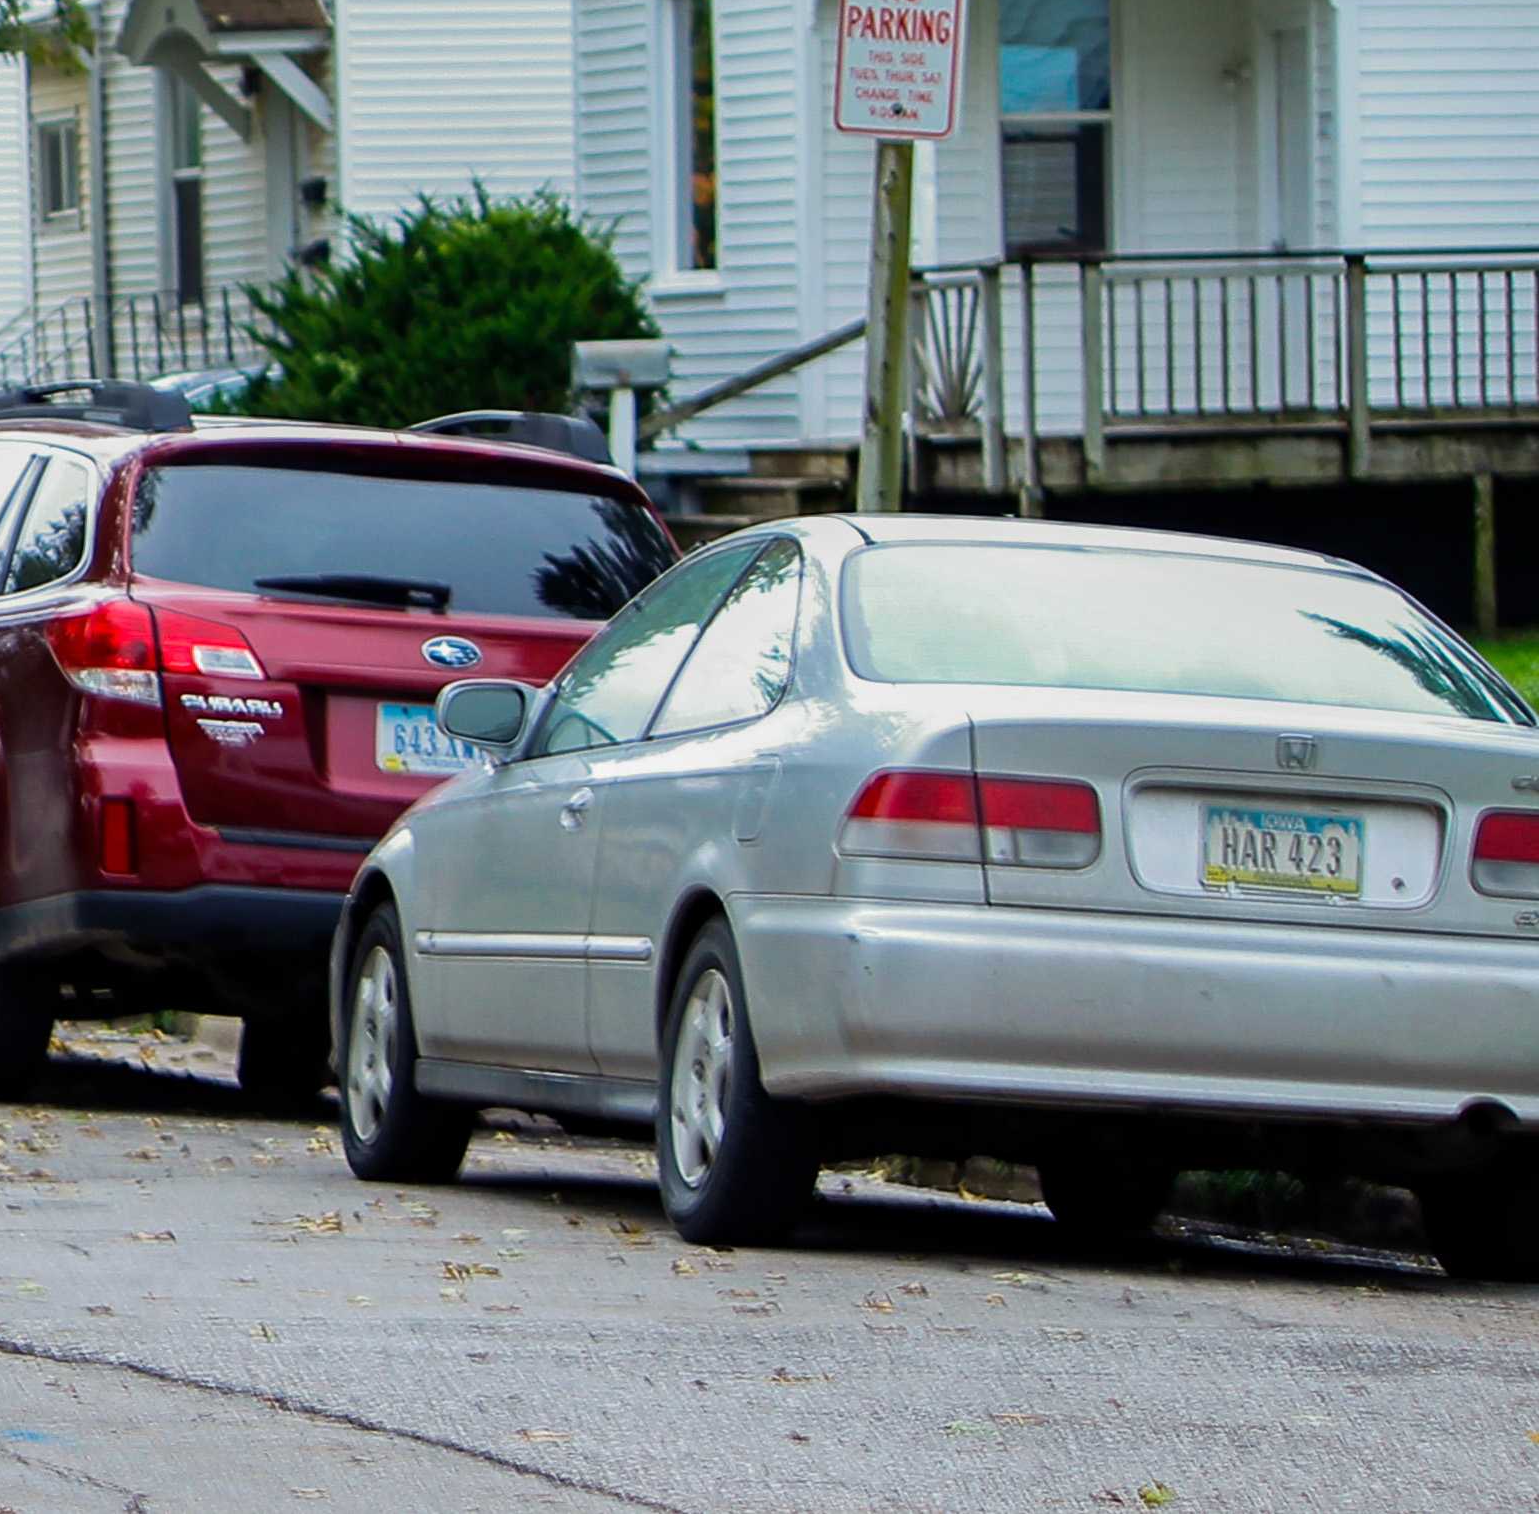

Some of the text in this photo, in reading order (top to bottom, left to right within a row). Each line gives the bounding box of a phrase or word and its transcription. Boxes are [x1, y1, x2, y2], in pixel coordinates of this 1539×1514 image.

[846, 5, 951, 45] PARKING
[869, 50, 925, 66] THIS SIDE
[855, 87, 934, 104] CHANGE TIME
[180, 693, 283, 717] SUBARU
[394, 724, 437, 757] 643
[1259, 813, 1307, 832] IOWA
[1222, 825, 1341, 877] HAR 423
